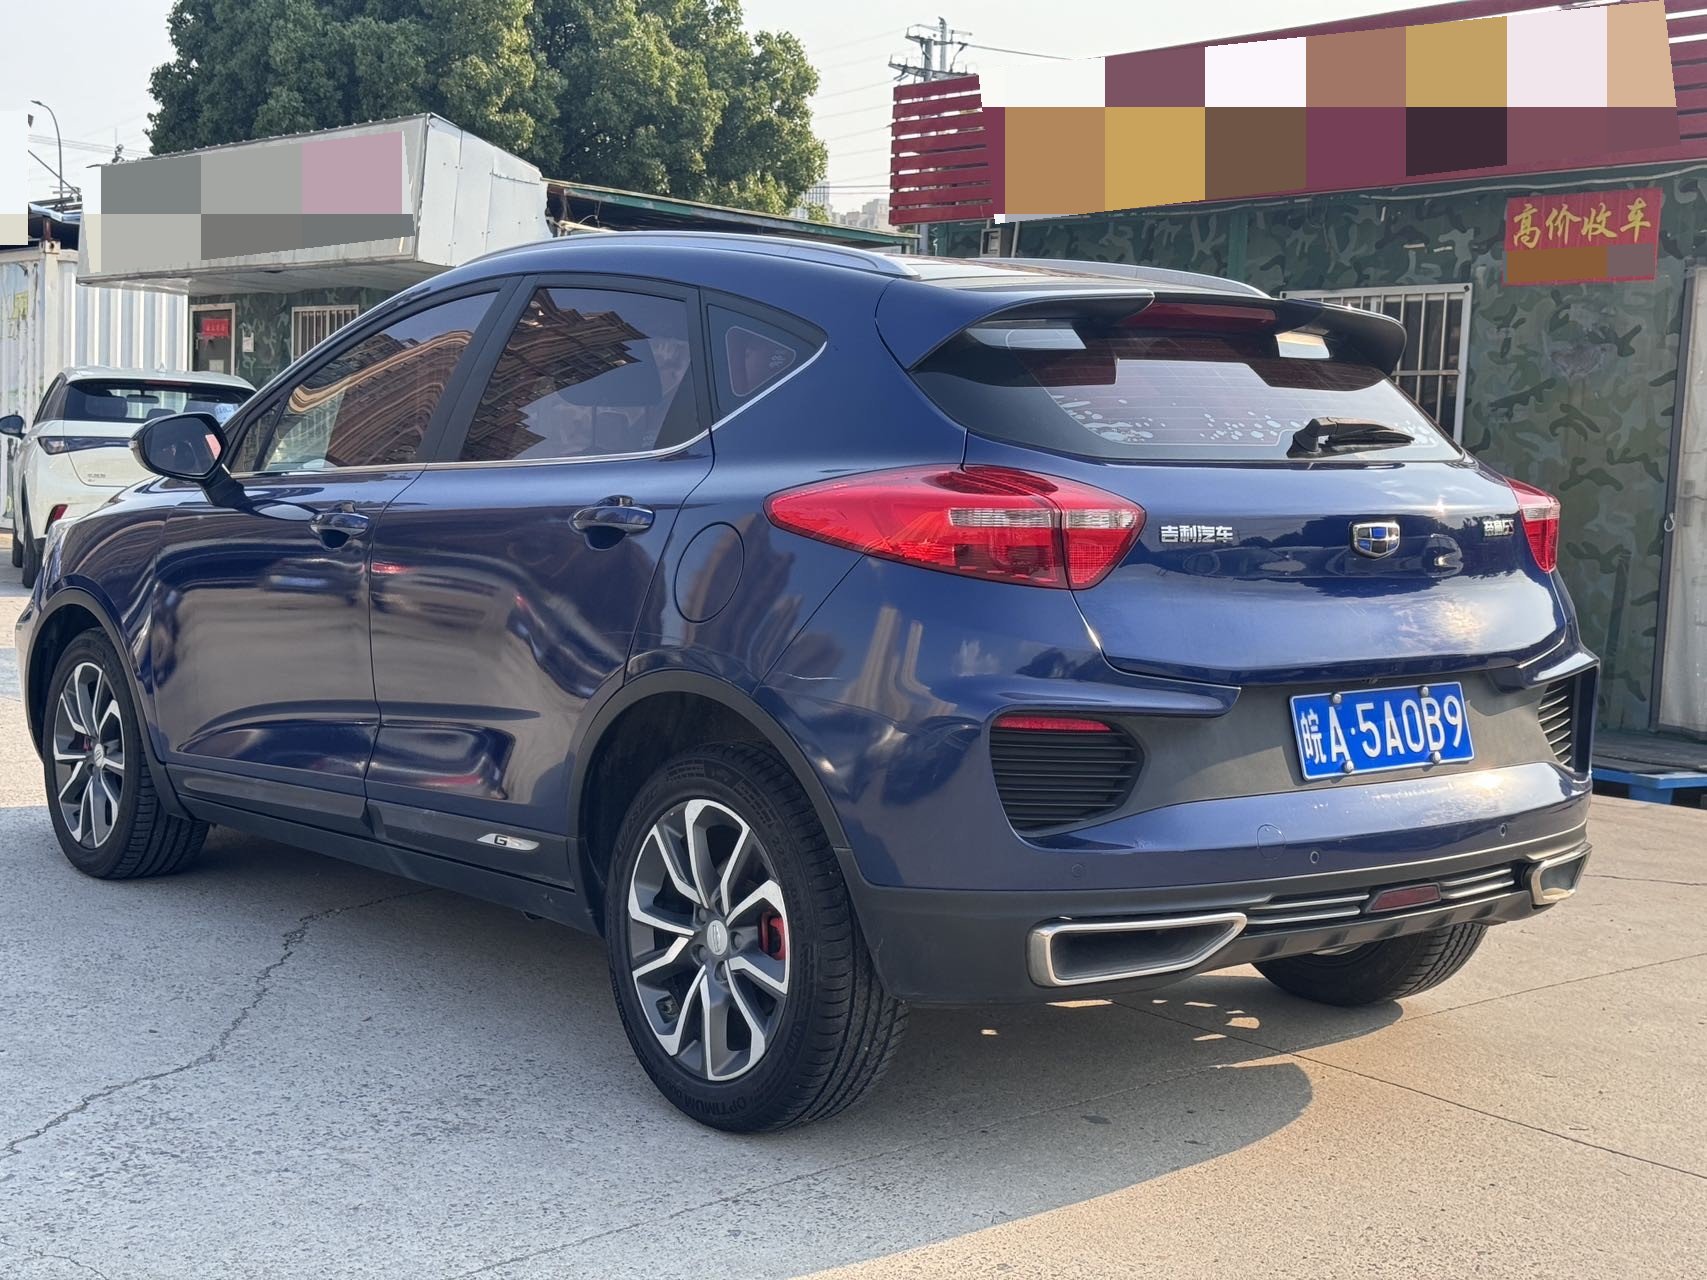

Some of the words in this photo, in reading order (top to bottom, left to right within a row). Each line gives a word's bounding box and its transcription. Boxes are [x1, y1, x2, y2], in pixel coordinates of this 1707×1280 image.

[1513, 197, 1651, 249] 高价收车
[1160, 525, 1234, 543] 吉利汽车
